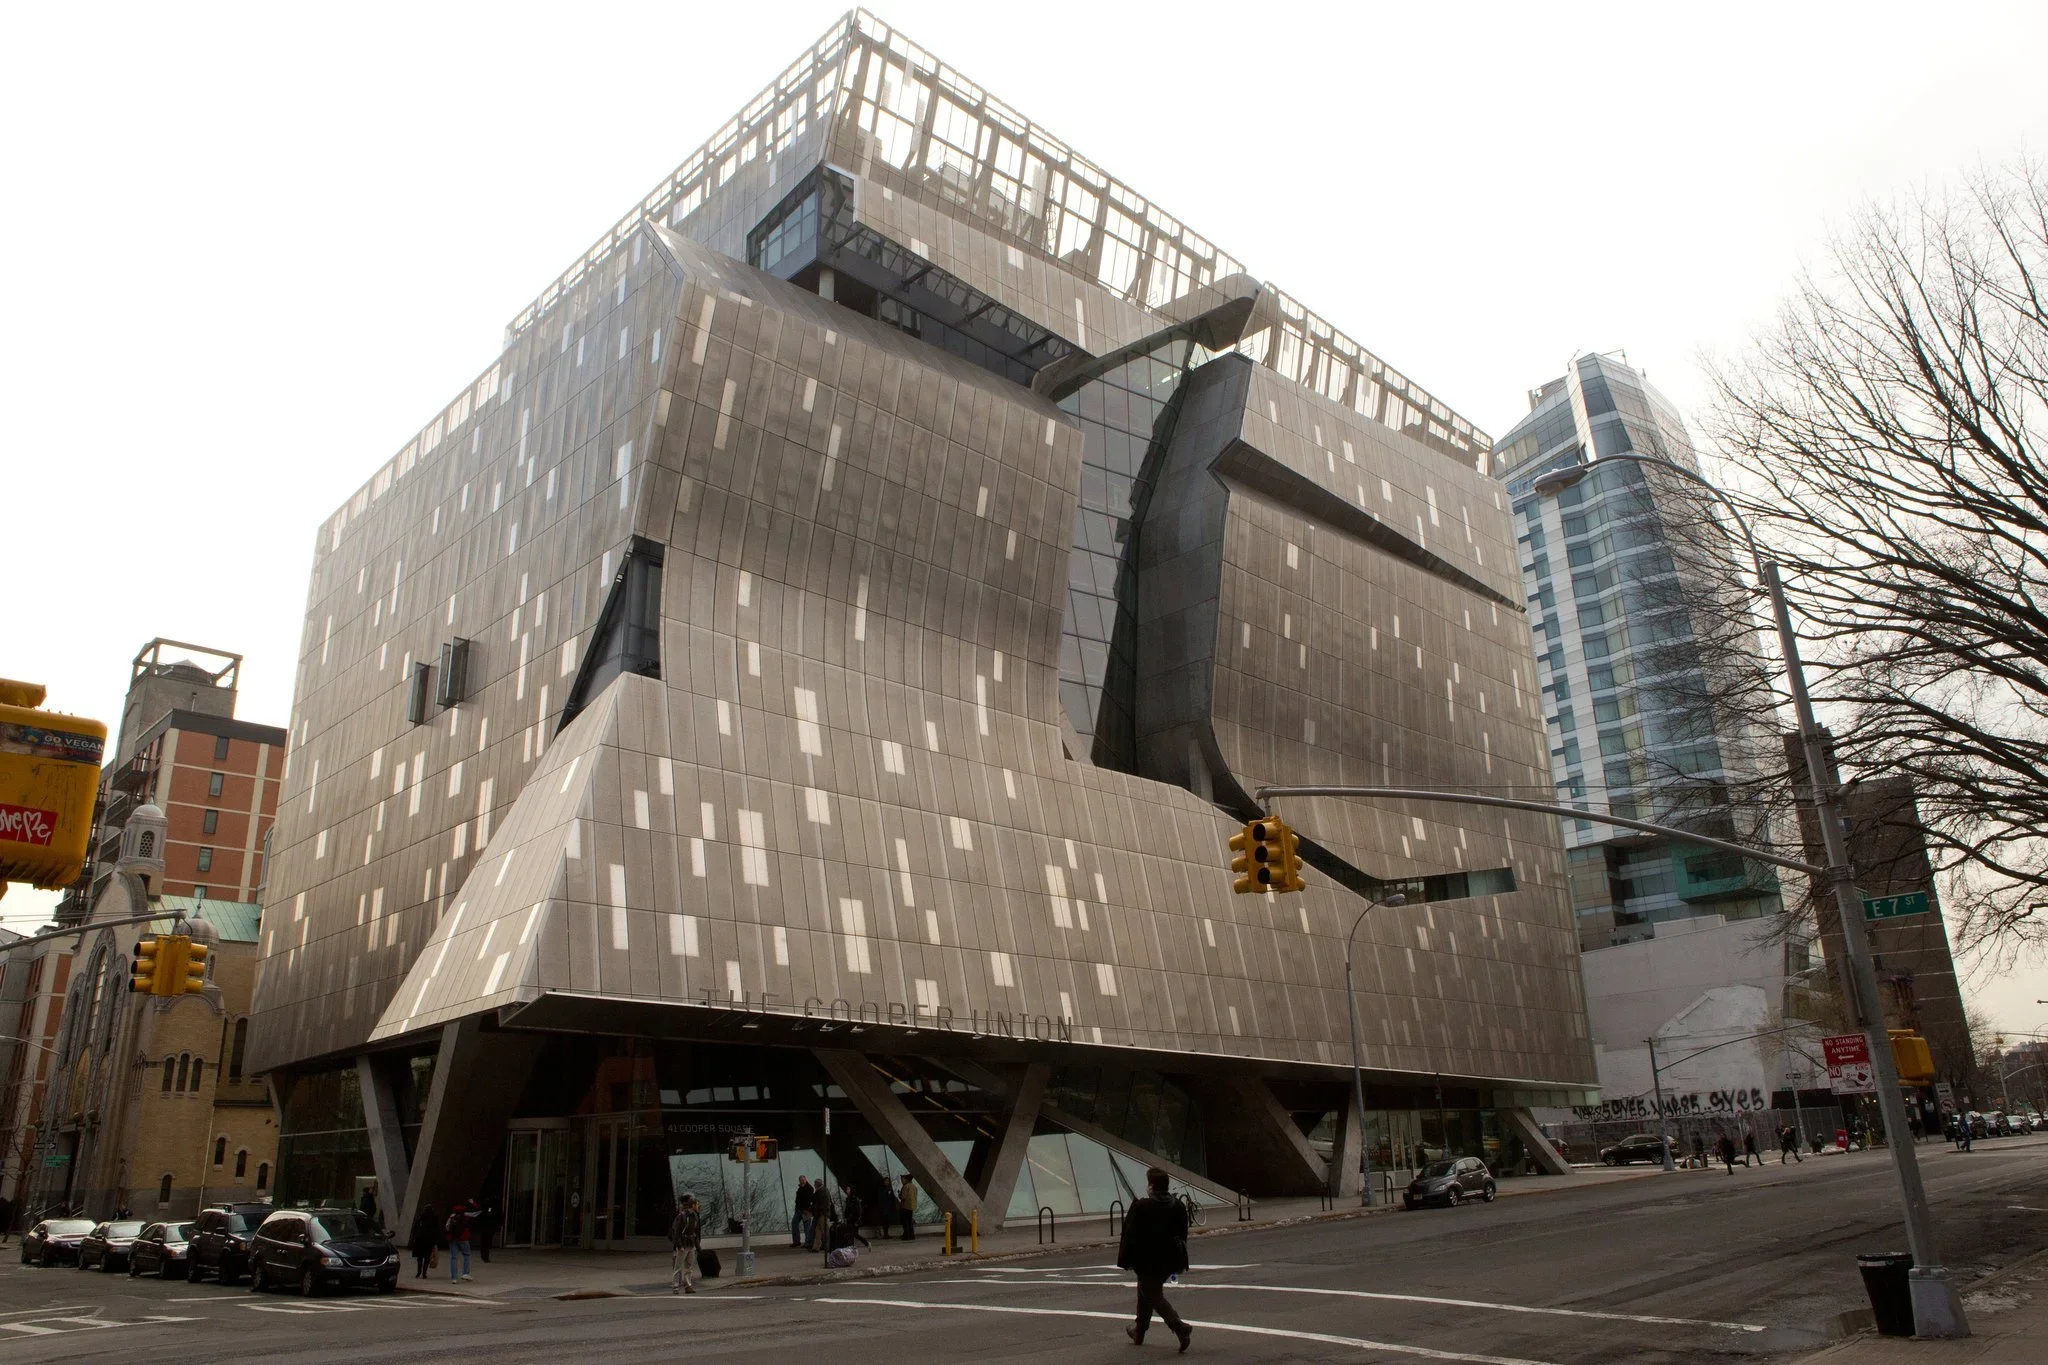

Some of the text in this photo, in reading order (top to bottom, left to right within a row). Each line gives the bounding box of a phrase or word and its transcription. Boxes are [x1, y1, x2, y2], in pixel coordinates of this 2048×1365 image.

[45, 735, 62, 744] GO
[65, 738, 104, 751] VEGAN
[1872, 896, 1915, 916] E 7 ST
[700, 989, 1073, 1043] THE COOPER UNION
[1835, 1036, 1864, 1046] STANDING
[1831, 1045, 1861, 1054] ANYTIME
[1829, 1066, 1841, 1077] NO
[667, 1124, 678, 1133] 41
[679, 1124, 716, 1133] COOPER
